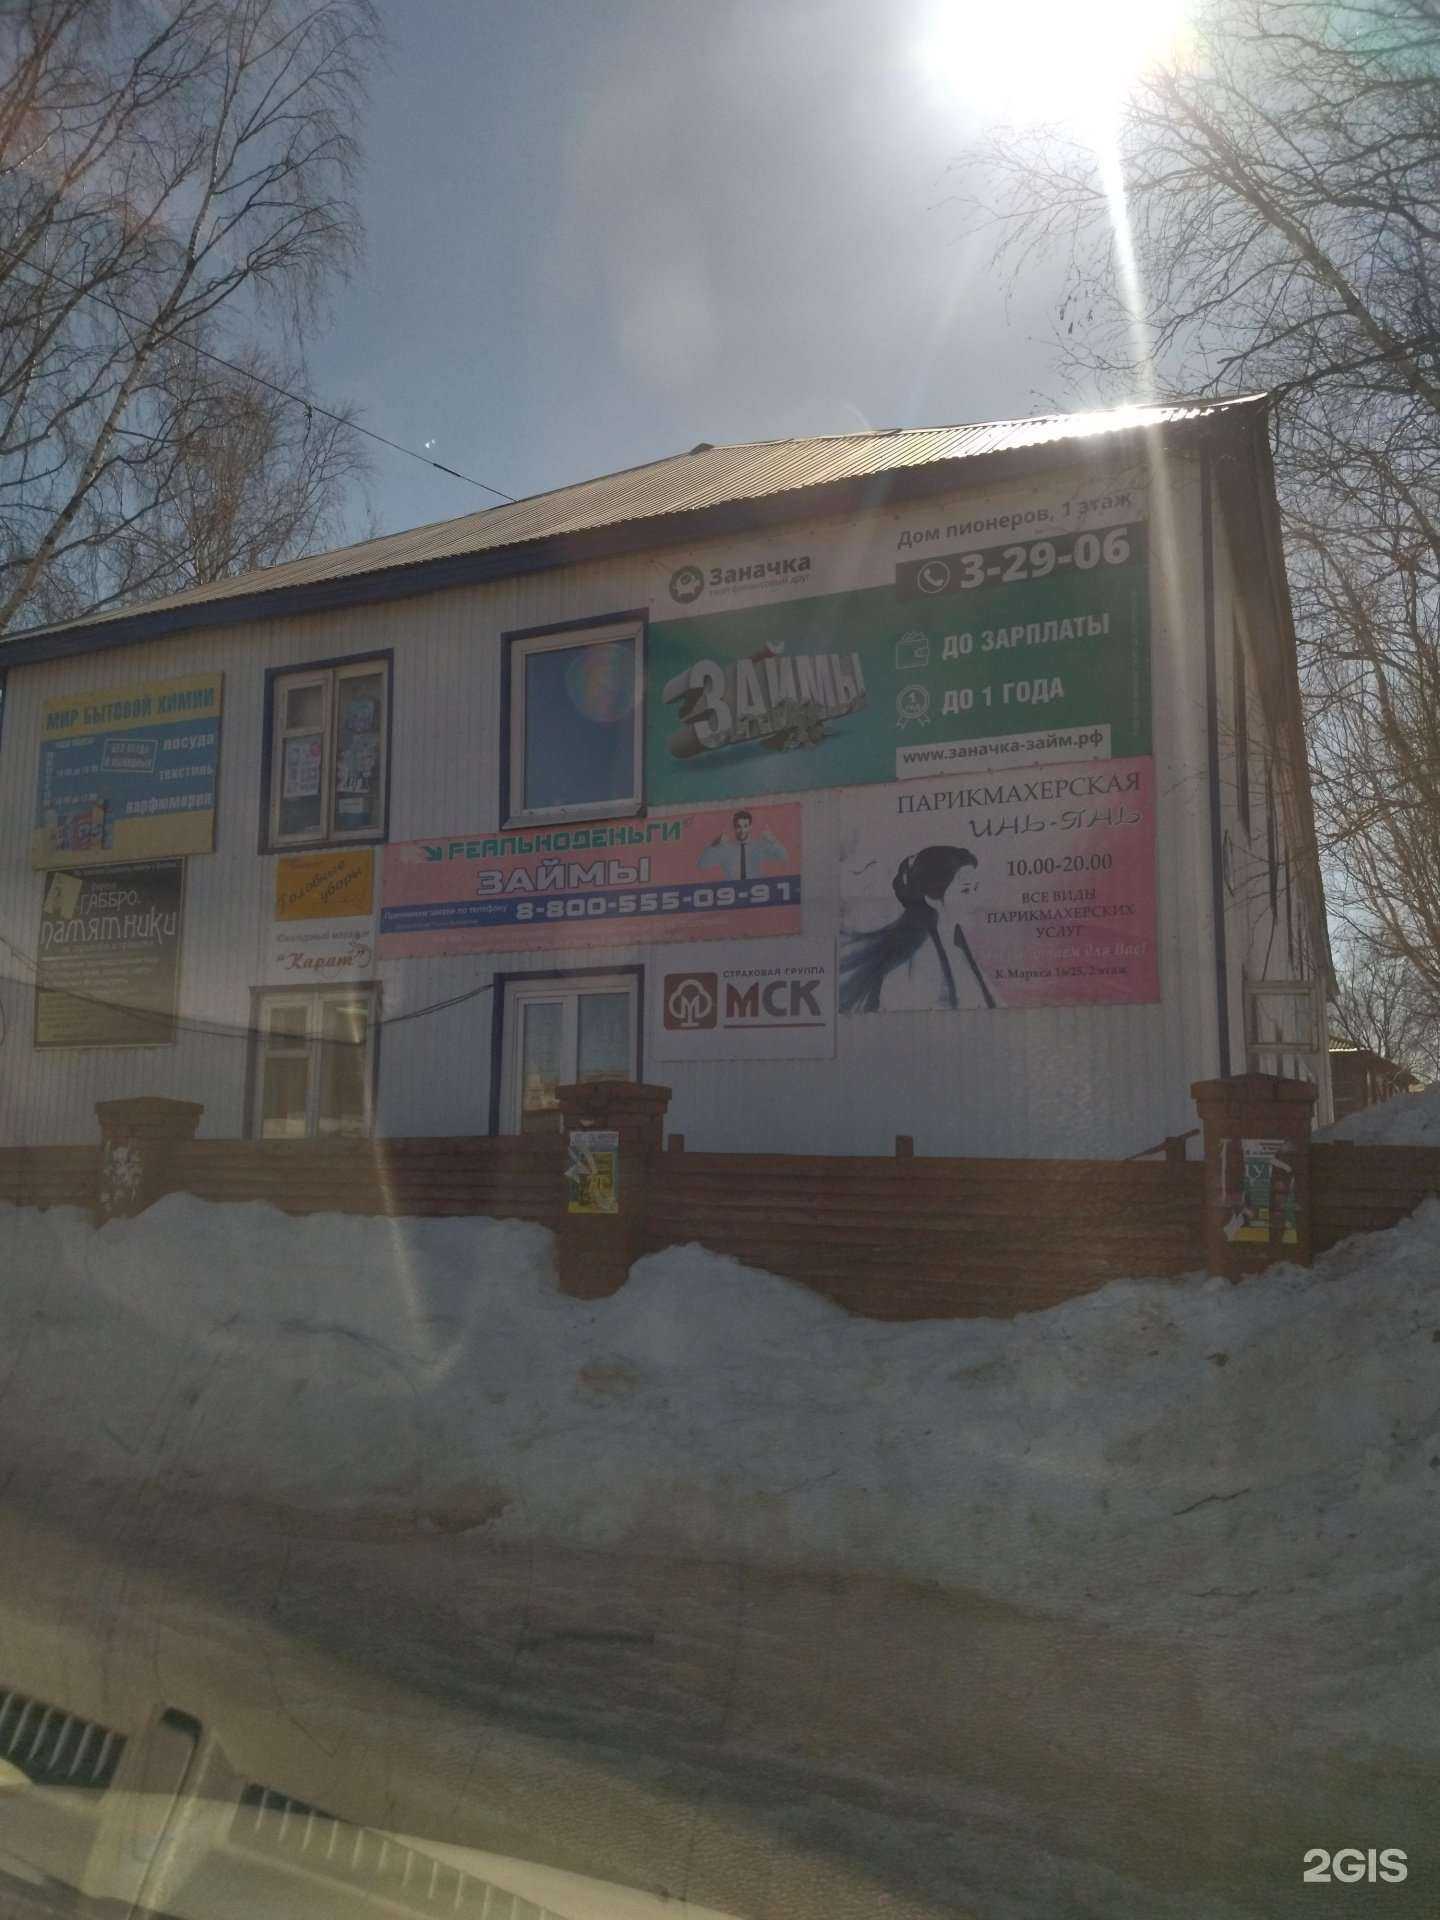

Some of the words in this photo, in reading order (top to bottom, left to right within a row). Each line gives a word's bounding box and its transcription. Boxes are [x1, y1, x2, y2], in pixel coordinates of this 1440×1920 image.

[897, 526, 940, 550] Дом
[946, 508, 1054, 538] пионеров,
[1062, 502, 1071, 517] 1
[1078, 491, 1134, 515] этаж
[709, 556, 811, 587] Заначка
[959, 527, 1131, 590] 3-29-06
[942, 631, 974, 660] ДО
[980, 612, 1111, 652] ЗАРПЛАТЫ
[46, 709, 79, 731] МИР
[83, 698, 152, 726] БЫТОВОЙ
[157, 687, 214, 714] ХИМИИ
[942, 687, 974, 716] ДО
[983, 686, 992, 706] 1
[1002, 676, 1065, 705] ГОДА
[163, 734, 215, 753] посуда
[902, 729, 1104, 764] www.заначка-займ.рф
[896, 771, 1142, 815] ПАРИКМАХЕРСКАЯ
[477, 856, 652, 896] ЗАЙМЫ
[1007, 853, 1113, 877] 10.00-20.00
[516, 882, 791, 920] 8-800-555-09-91
[986, 904, 1137, 924] ПАРИКМАХЕРСКИХ
[1022, 890, 1049, 905] ВСЕ
[1053, 887, 1097, 902] ВИДЫ
[1035, 925, 1082, 939] УСЛУГ
[722, 968, 781, 979] СТРАХОВАЯ
[785, 965, 825, 976] ГРУППА
[726, 979, 821, 1018] МСК
